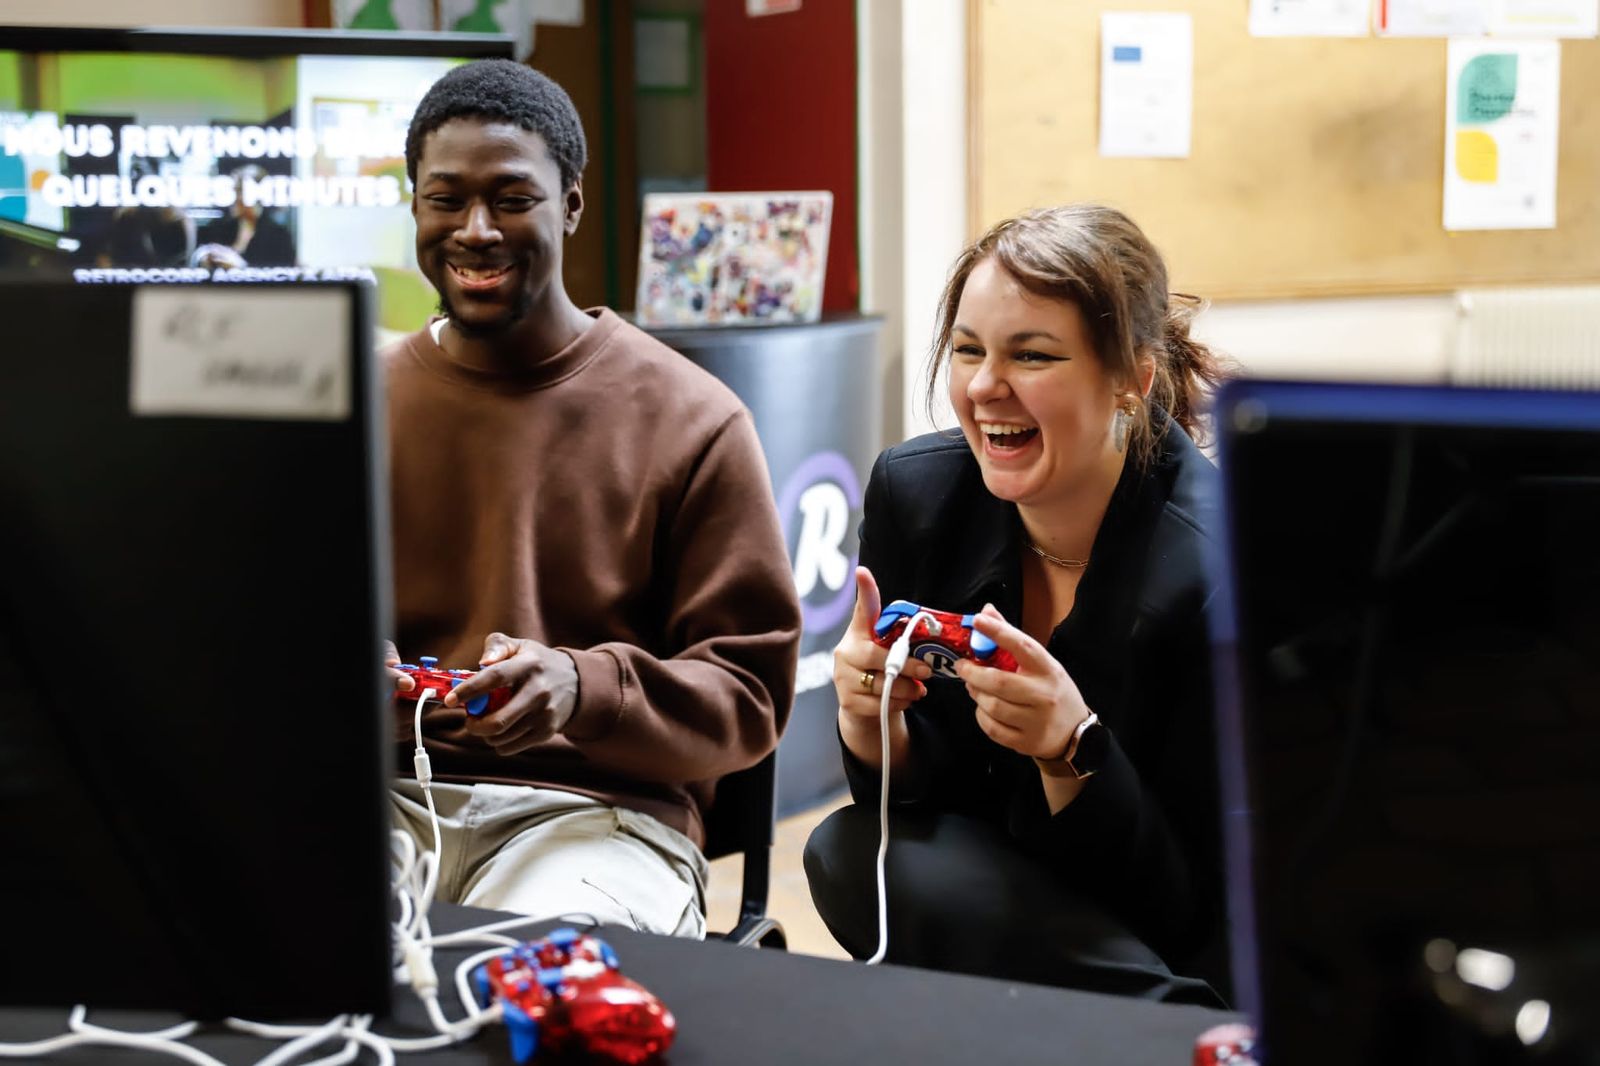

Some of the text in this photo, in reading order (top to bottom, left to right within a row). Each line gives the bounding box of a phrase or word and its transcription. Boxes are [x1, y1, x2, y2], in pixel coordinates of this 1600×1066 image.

[5, 124, 114, 157] NOUS
[42, 174, 400, 207] QUELQUES MINUTES
[73, 268, 210, 283] RETROCORP
[795, 483, 849, 599] R
[929, 652, 958, 677] R
